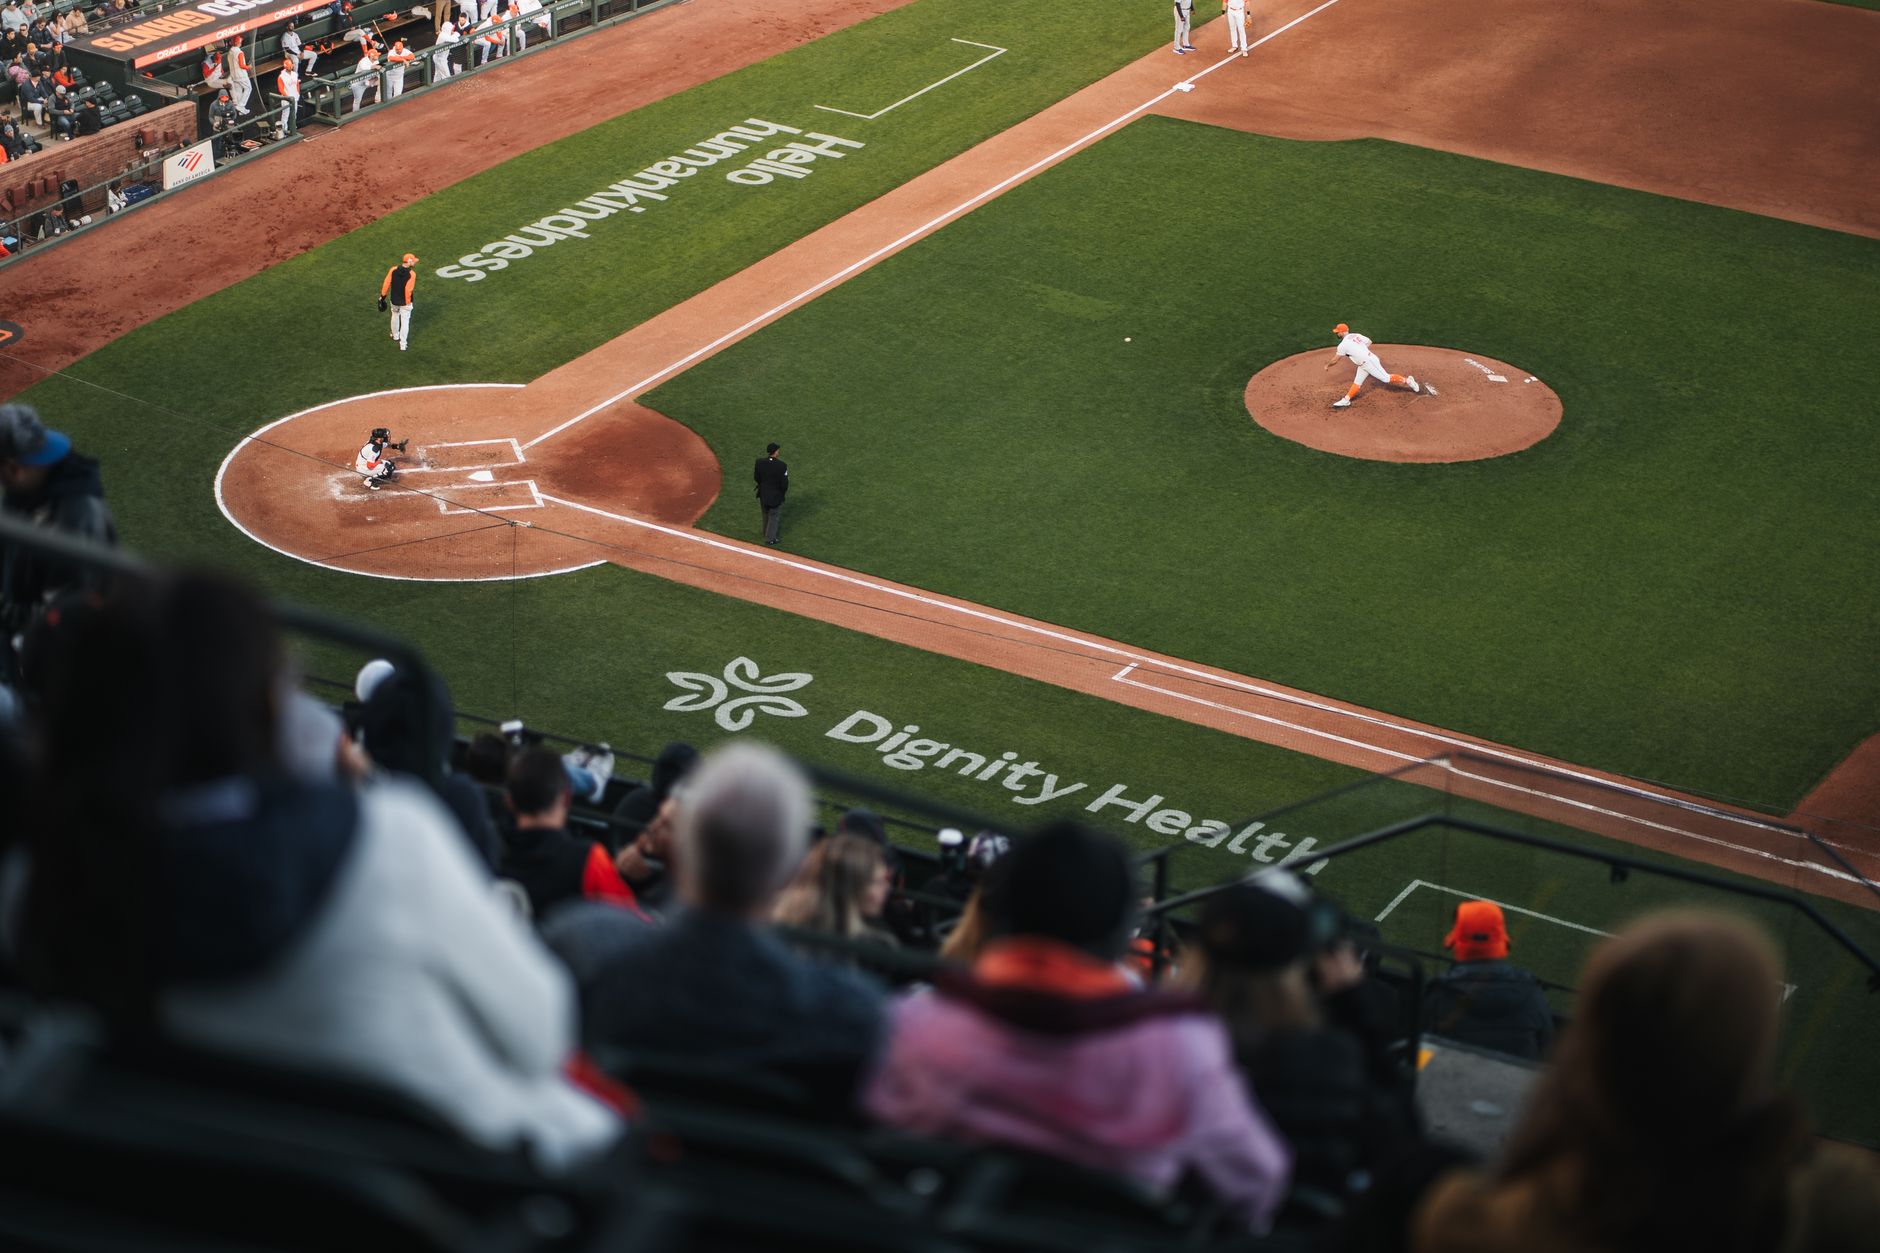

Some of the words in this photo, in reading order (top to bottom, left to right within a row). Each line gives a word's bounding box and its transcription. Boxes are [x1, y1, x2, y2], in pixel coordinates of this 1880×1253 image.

[274, 4, 305, 20] ORACLE
[91, 10, 216, 52] GIANTS
[216, 23, 247, 40] ORACLE
[156, 43, 188, 60] ORACLE
[726, 131, 866, 186] Hello
[172, 177, 185, 186] BANK
[192, 168, 211, 179] AMERICA
[435, 117, 803, 283] humankindness
[825, 709, 1088, 806] Dignity
[1085, 783, 1330, 876] Health
